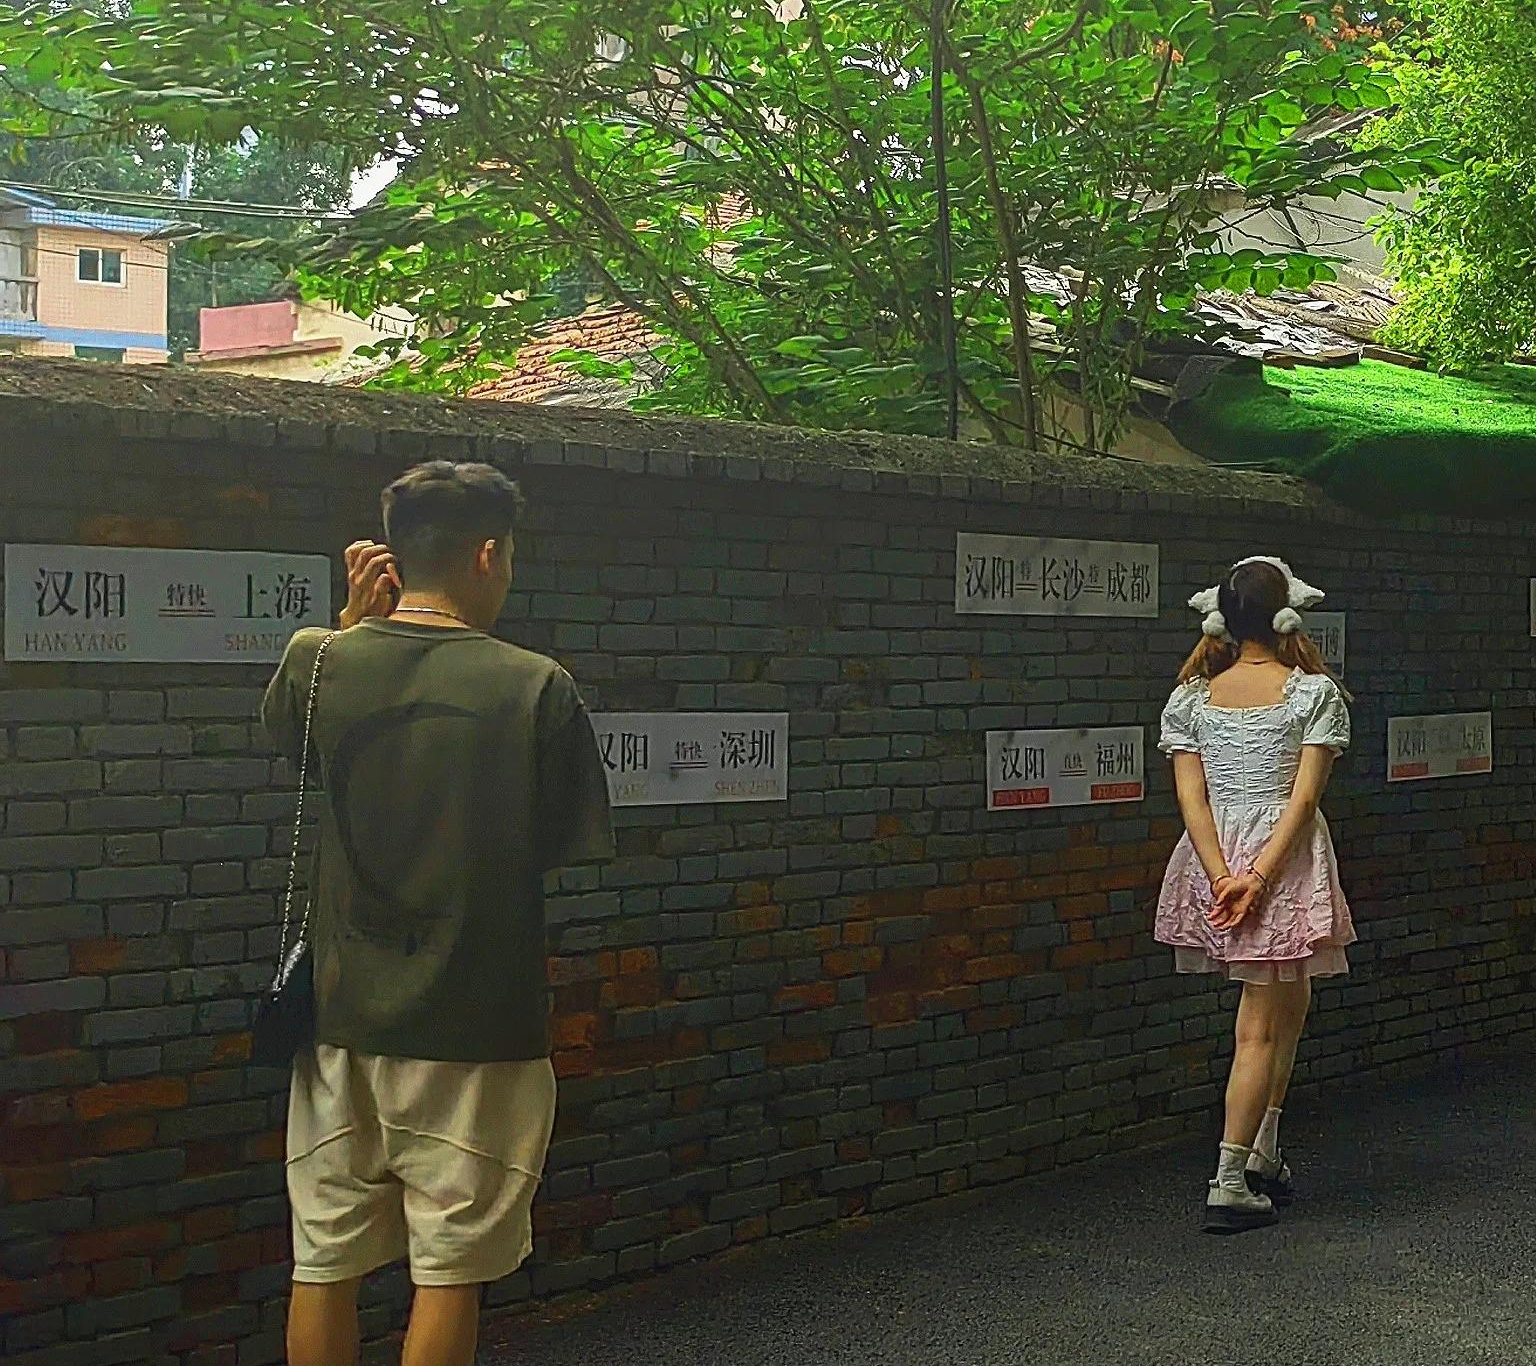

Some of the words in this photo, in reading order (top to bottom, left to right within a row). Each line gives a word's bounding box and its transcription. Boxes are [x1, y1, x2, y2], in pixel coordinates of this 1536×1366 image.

[35, 567, 127, 620] 汉阳
[232, 572, 313, 620] 上海
[964, 553, 1015, 601] 汉阳
[1040, 556, 1085, 602] 长沙
[1107, 561, 1151, 604] 成都
[719, 729, 776, 770] 深圳
[1001, 746, 1046, 782] 汉阳
[1095, 741, 1135, 777] 福州
